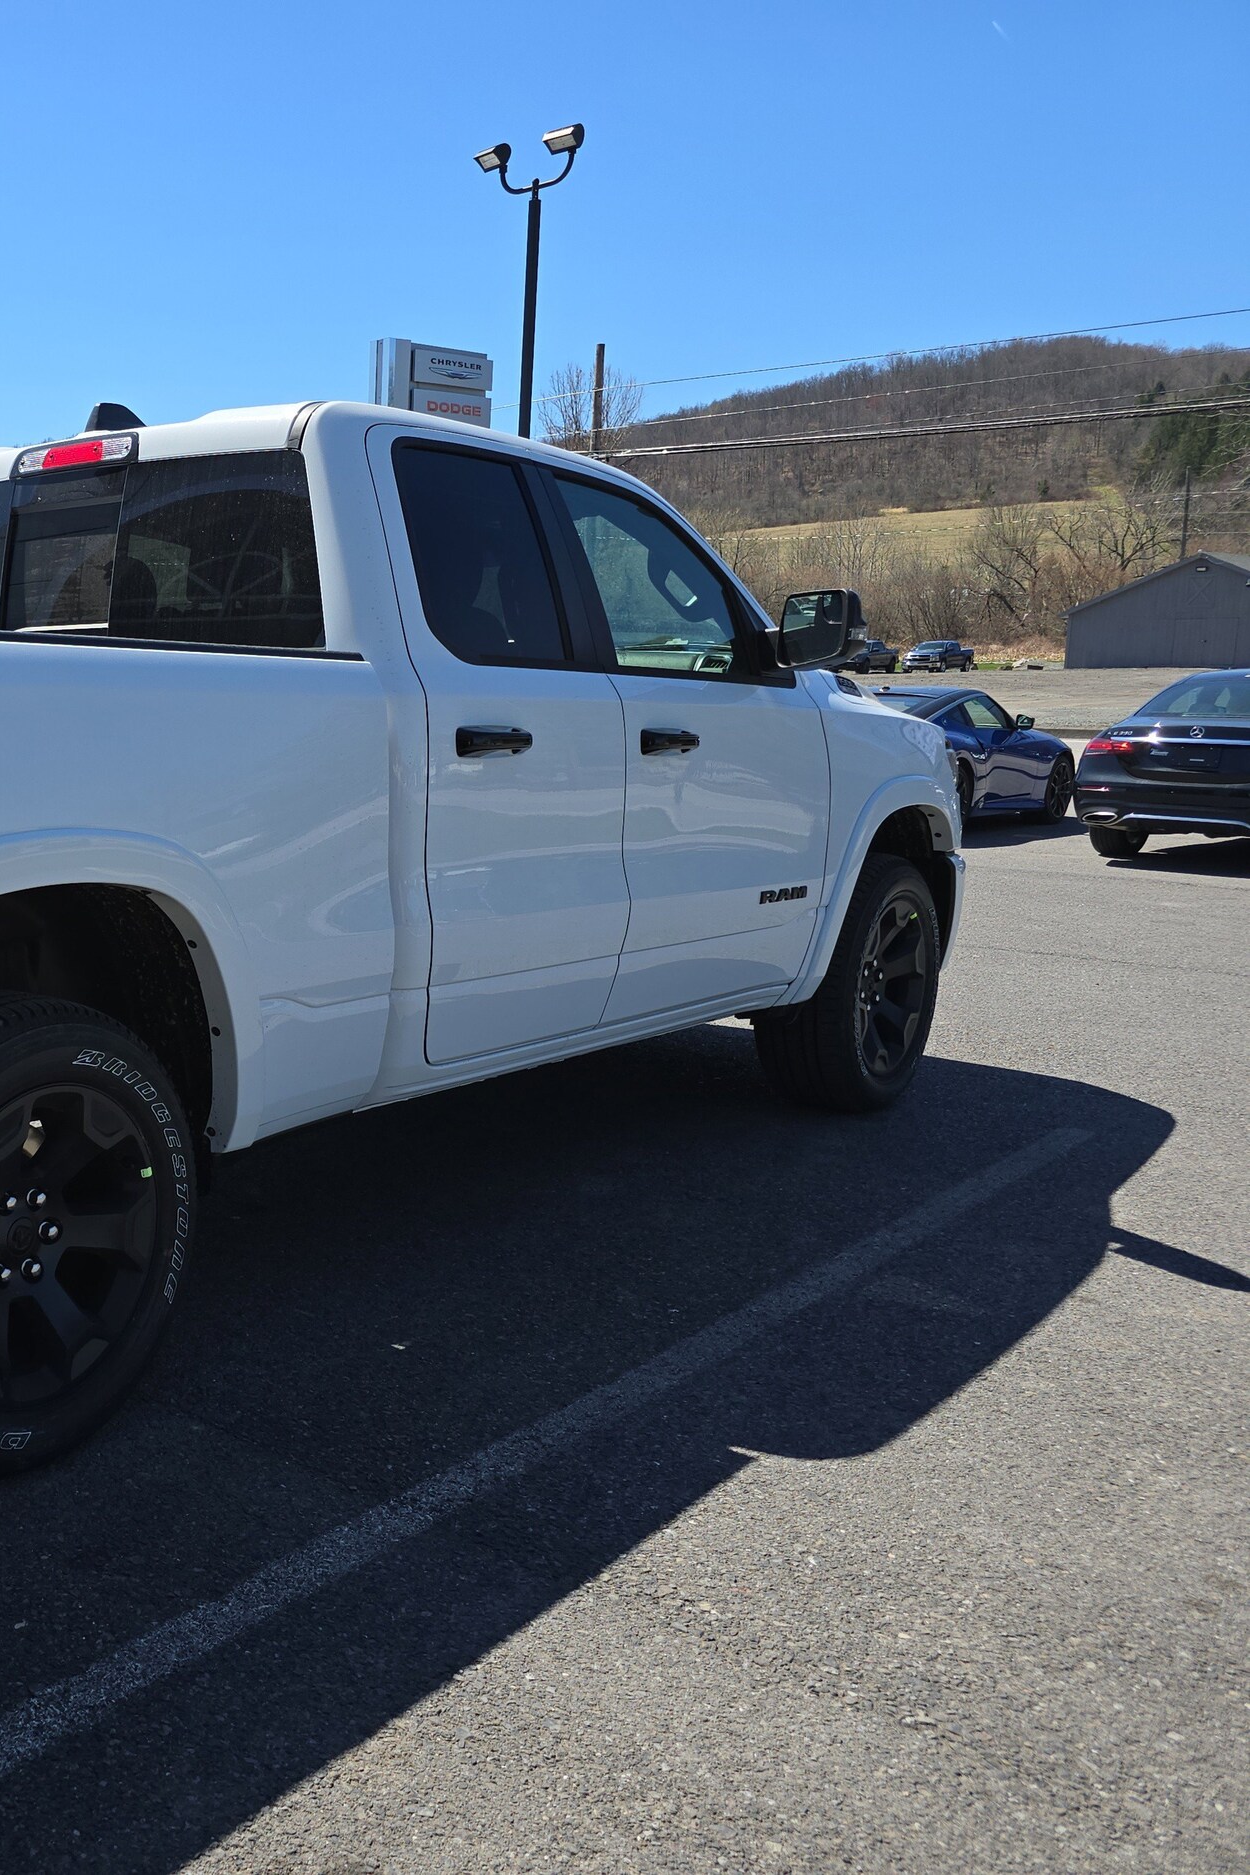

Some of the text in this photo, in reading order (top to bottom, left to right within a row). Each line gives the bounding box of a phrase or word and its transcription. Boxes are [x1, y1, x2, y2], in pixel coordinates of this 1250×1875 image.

[430, 358, 482, 371] CHRYSLER
[427, 401, 481, 416] DODGE
[759, 885, 807, 905] RAM
[72, 1049, 190, 1304] BRIDGESTONE
